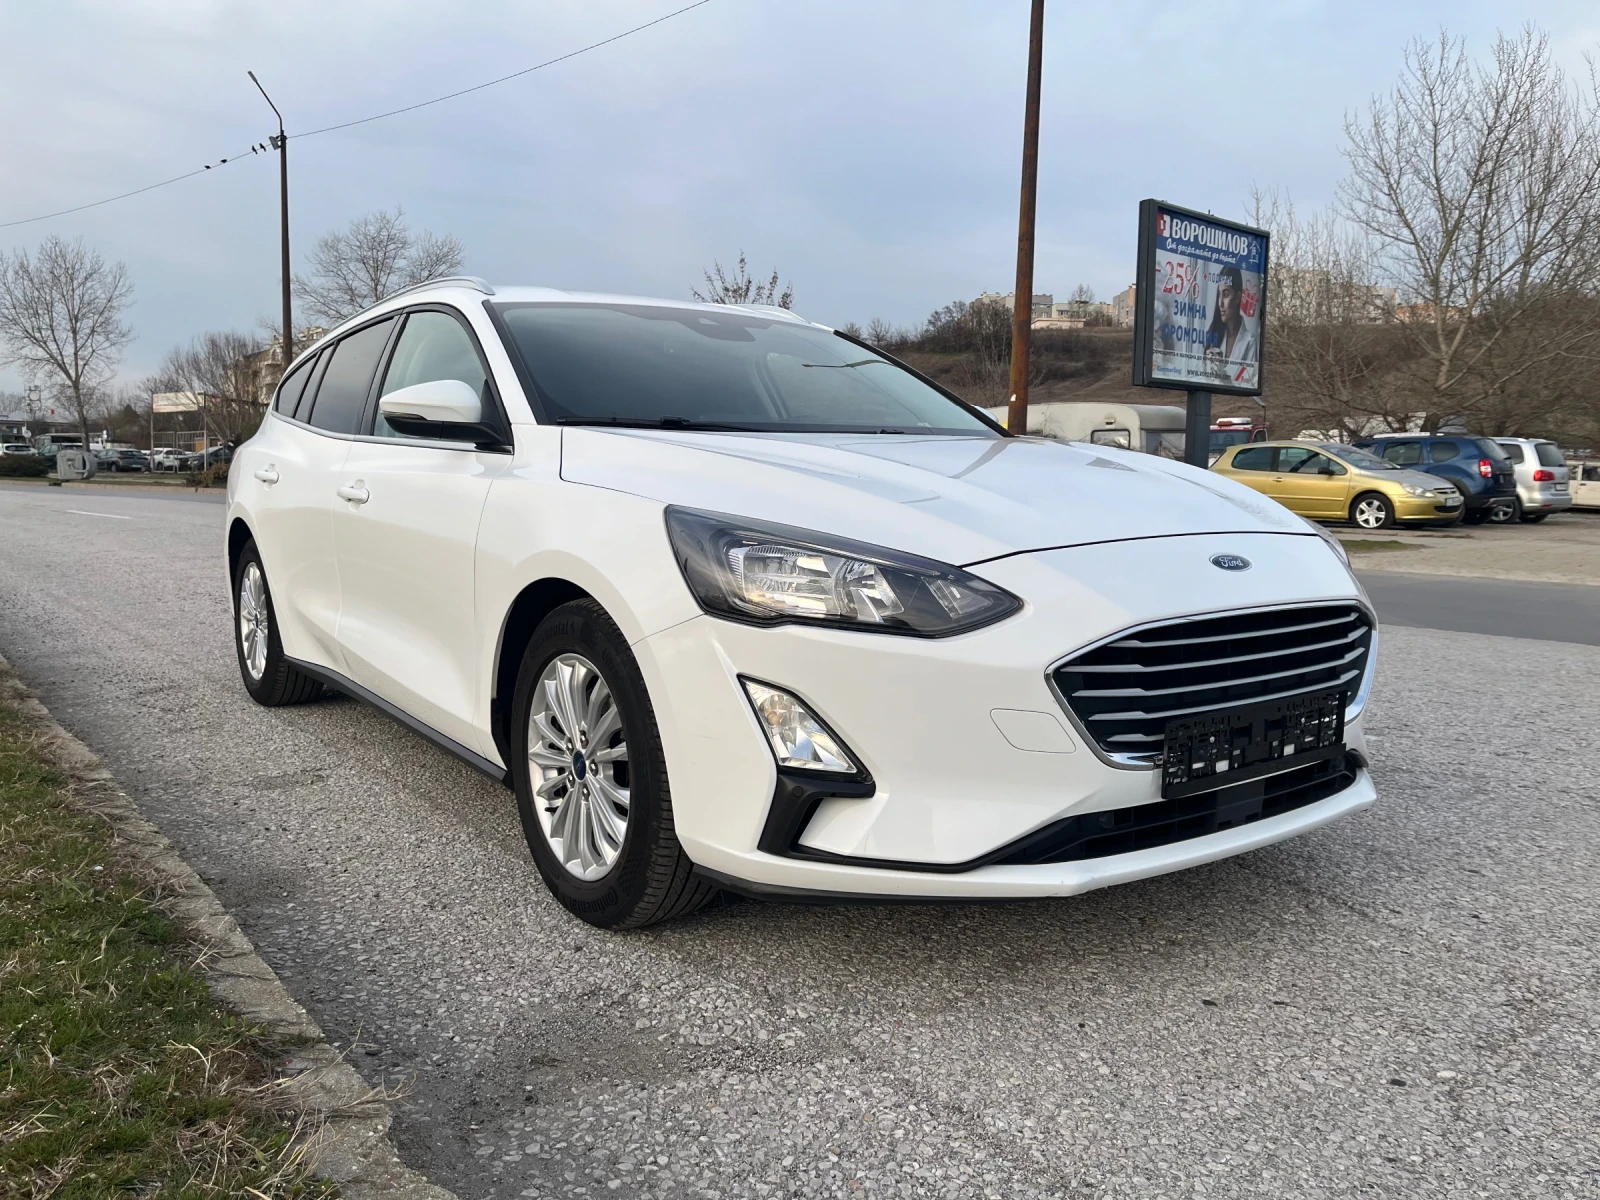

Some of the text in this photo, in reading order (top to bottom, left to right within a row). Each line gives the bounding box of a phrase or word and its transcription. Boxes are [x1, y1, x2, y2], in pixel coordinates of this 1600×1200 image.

[1171, 218, 1249, 256] ВОРОШИЛОВ
[1173, 299, 1207, 320] ЗИМНА
[1161, 323, 1219, 348] ПРОМОЦИЯ
[1218, 556, 1244, 567] Ford
[528, 619, 569, 660] Continental
[568, 886, 619, 915] Continental
